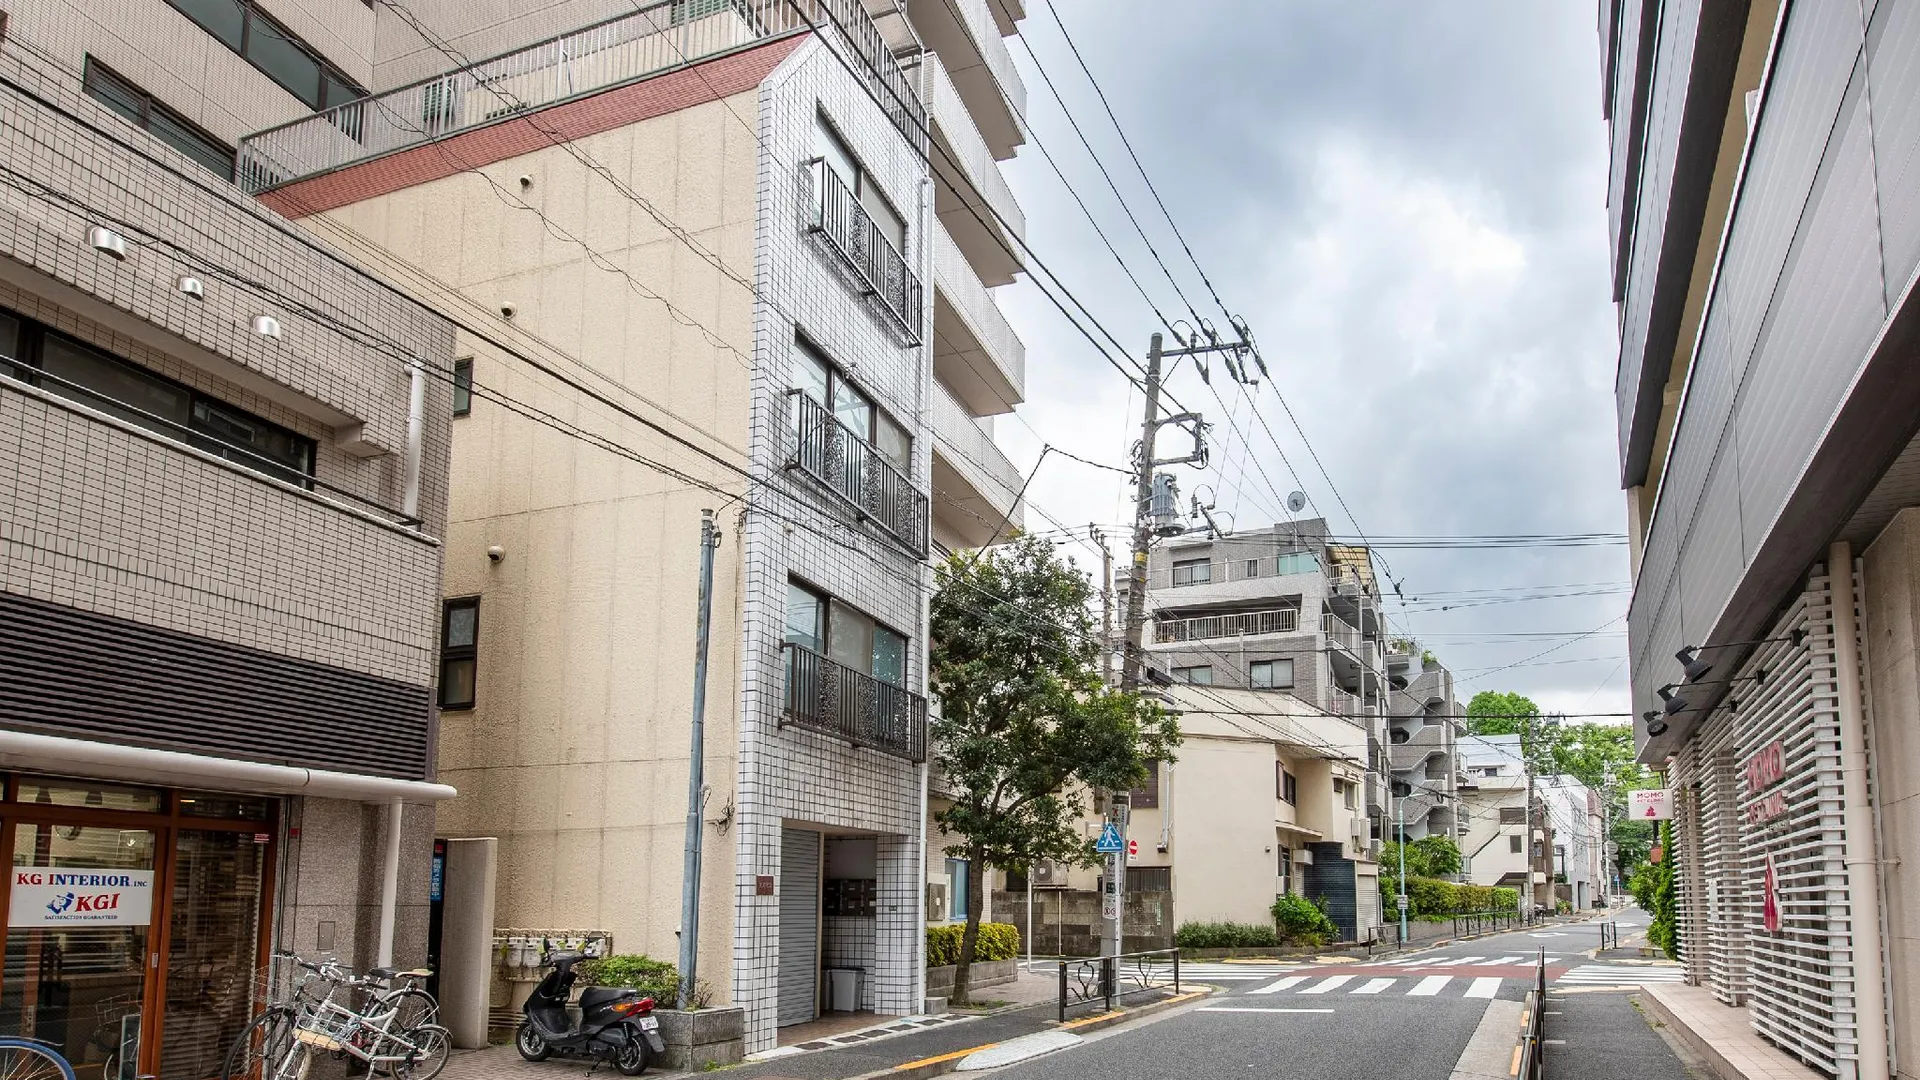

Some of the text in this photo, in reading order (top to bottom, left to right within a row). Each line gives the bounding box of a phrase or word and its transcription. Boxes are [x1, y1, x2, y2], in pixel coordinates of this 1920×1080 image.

[1747, 740, 1785, 792] MOMO
[17, 873, 42, 885] KG
[48, 873, 130, 887] INTERIOR
[75, 893, 120, 912] KGI
